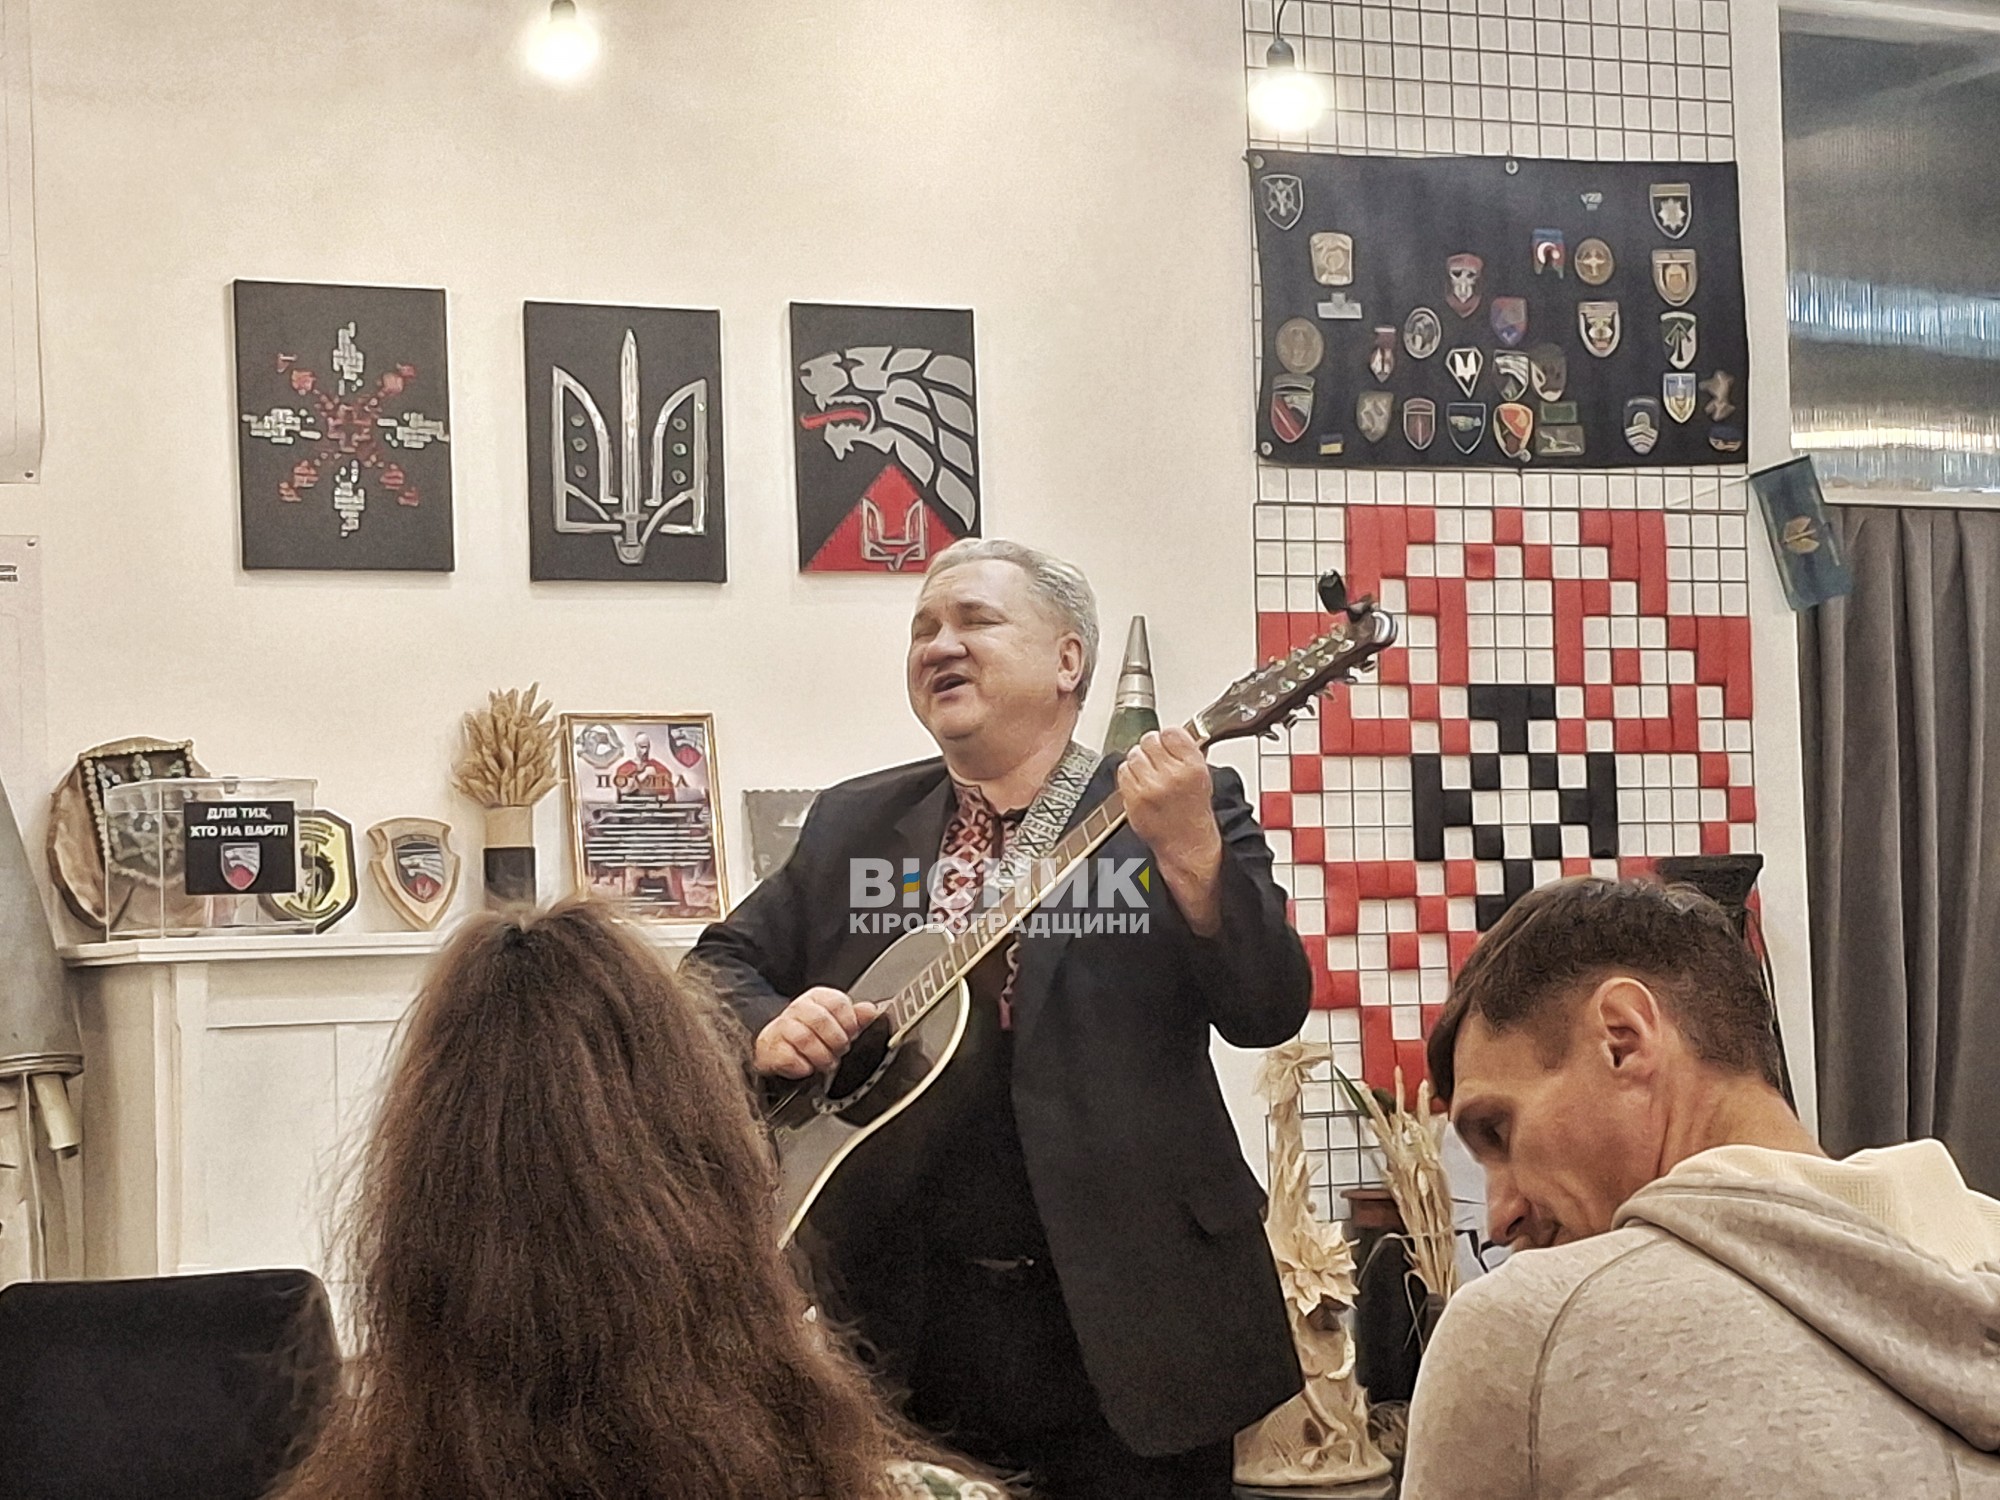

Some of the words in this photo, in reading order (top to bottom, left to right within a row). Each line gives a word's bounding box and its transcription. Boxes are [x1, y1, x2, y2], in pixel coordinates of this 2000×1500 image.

[206, 807, 238, 820] ДЛЯ
[190, 825, 218, 837] ХТО
[220, 825, 242, 837] НА
